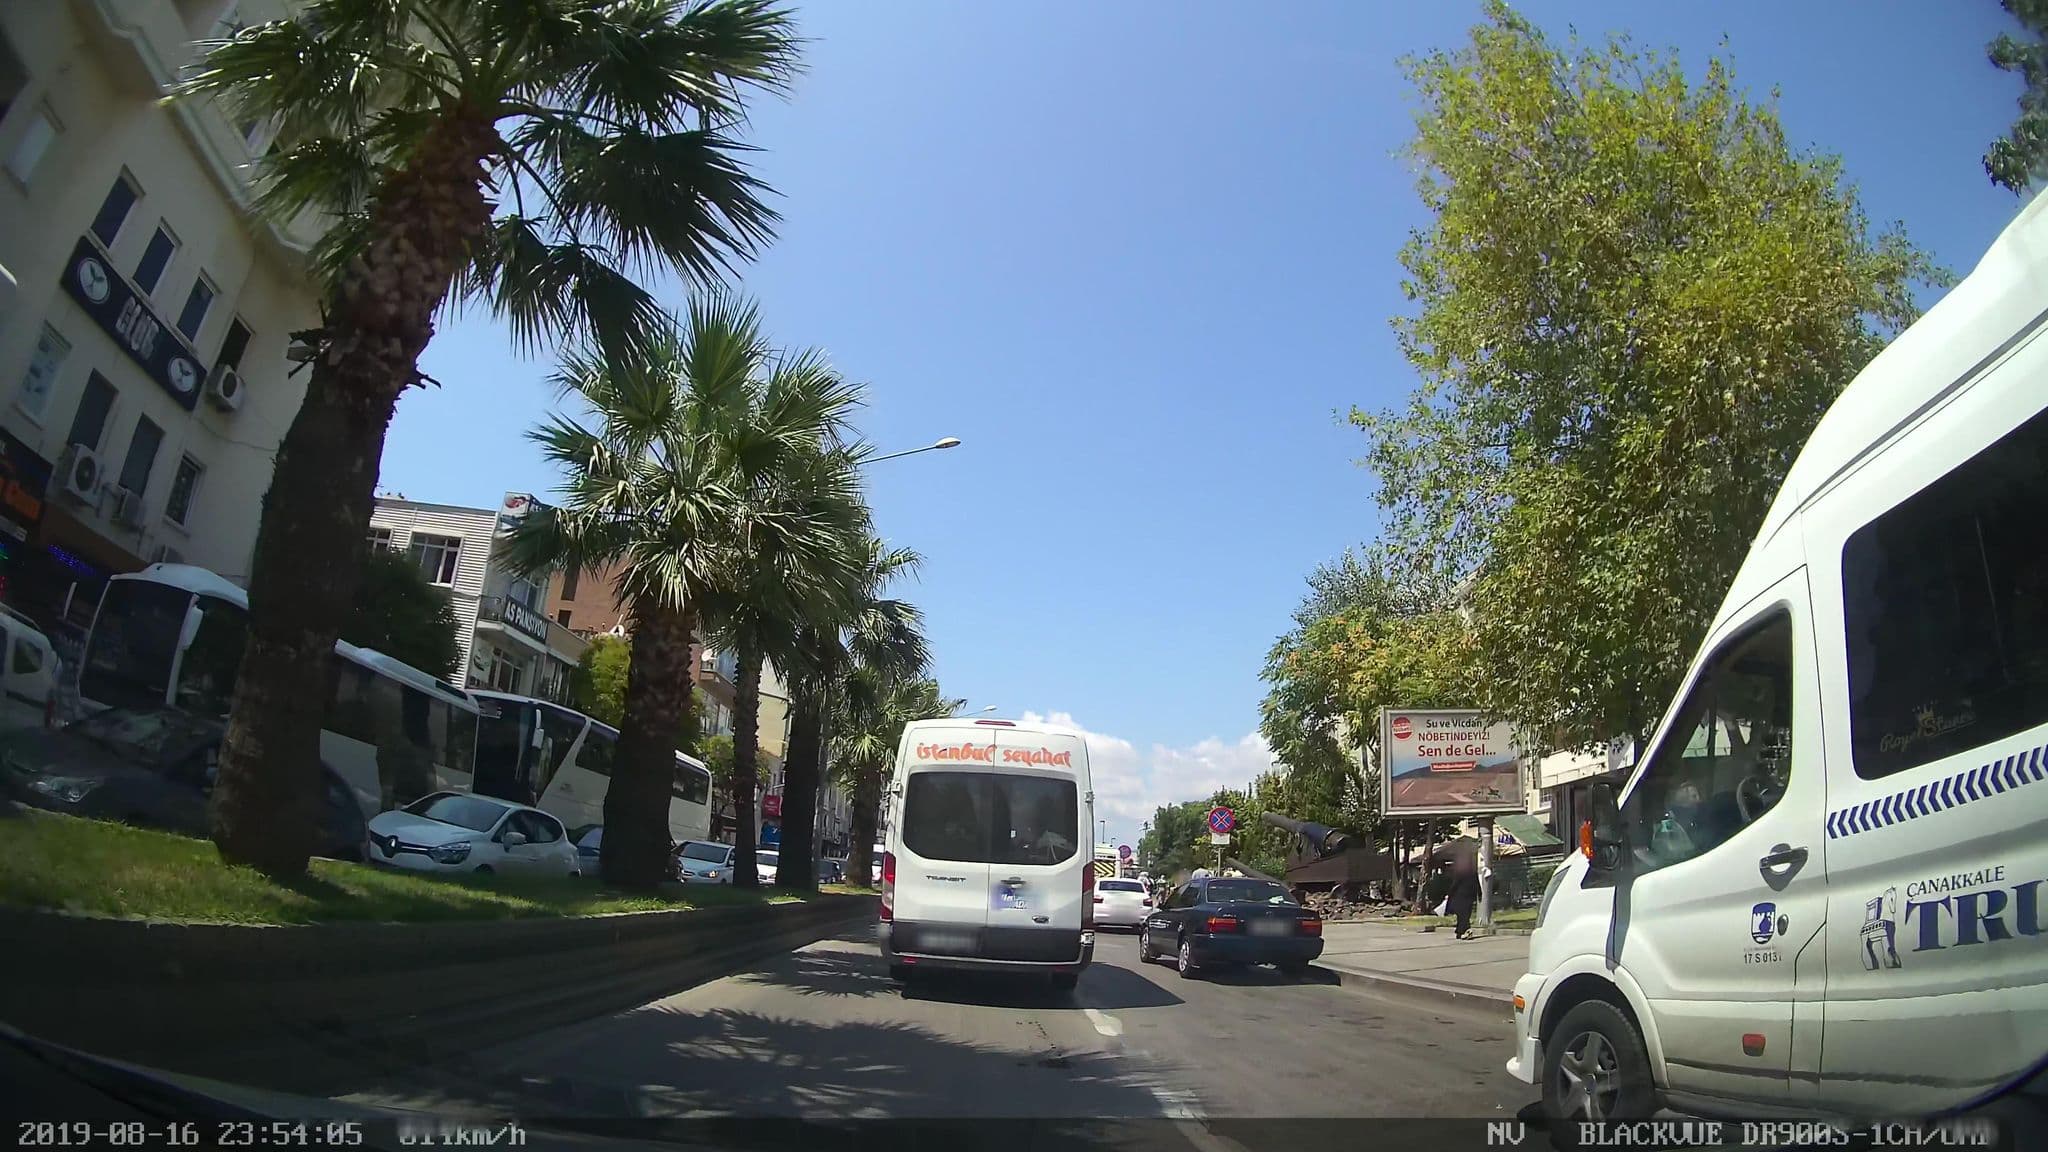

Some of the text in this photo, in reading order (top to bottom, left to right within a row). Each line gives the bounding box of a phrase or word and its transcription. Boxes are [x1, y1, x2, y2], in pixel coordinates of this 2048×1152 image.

[1426, 719, 1438, 729] Su
[1440, 720, 1451, 729] ve
[1003, 746, 1072, 768] seyahat
[1418, 743, 1496, 757] Sen de Gel...
[1906, 865, 2005, 900] ÇANAKKALE
[1744, 952, 1753, 964] 17
[1755, 953, 1761, 963] S
